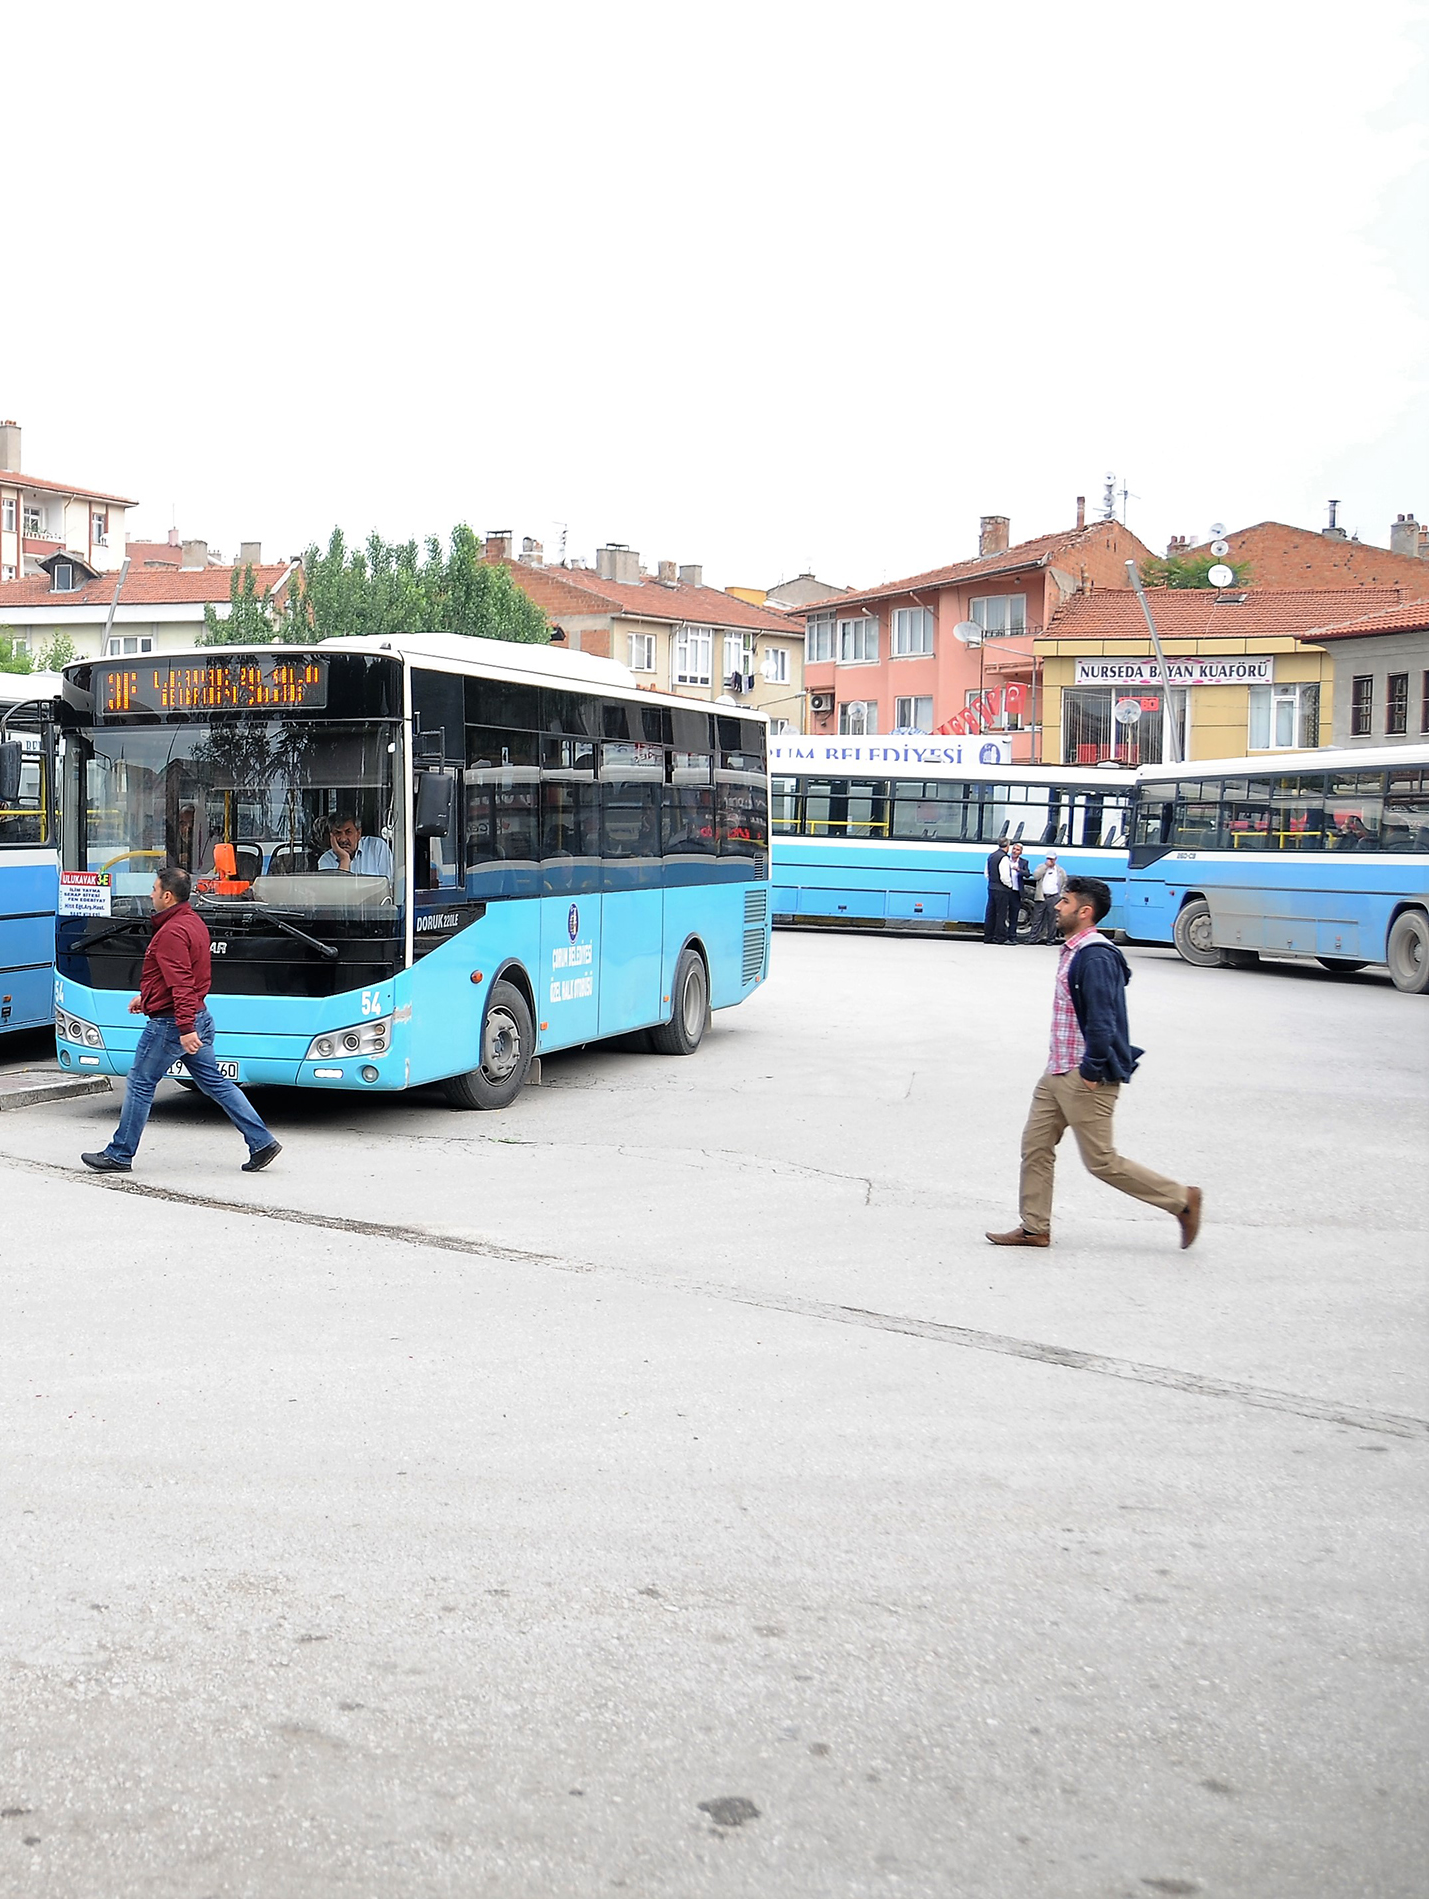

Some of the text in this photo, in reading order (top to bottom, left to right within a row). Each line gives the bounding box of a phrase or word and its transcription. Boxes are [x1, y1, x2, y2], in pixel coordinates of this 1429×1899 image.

[1080, 664, 1144, 679] NURSEDA
[1199, 661, 1268, 678] KUAFÖRÜ
[416, 913, 444, 932] DORUK
[361, 991, 382, 1015] 54
